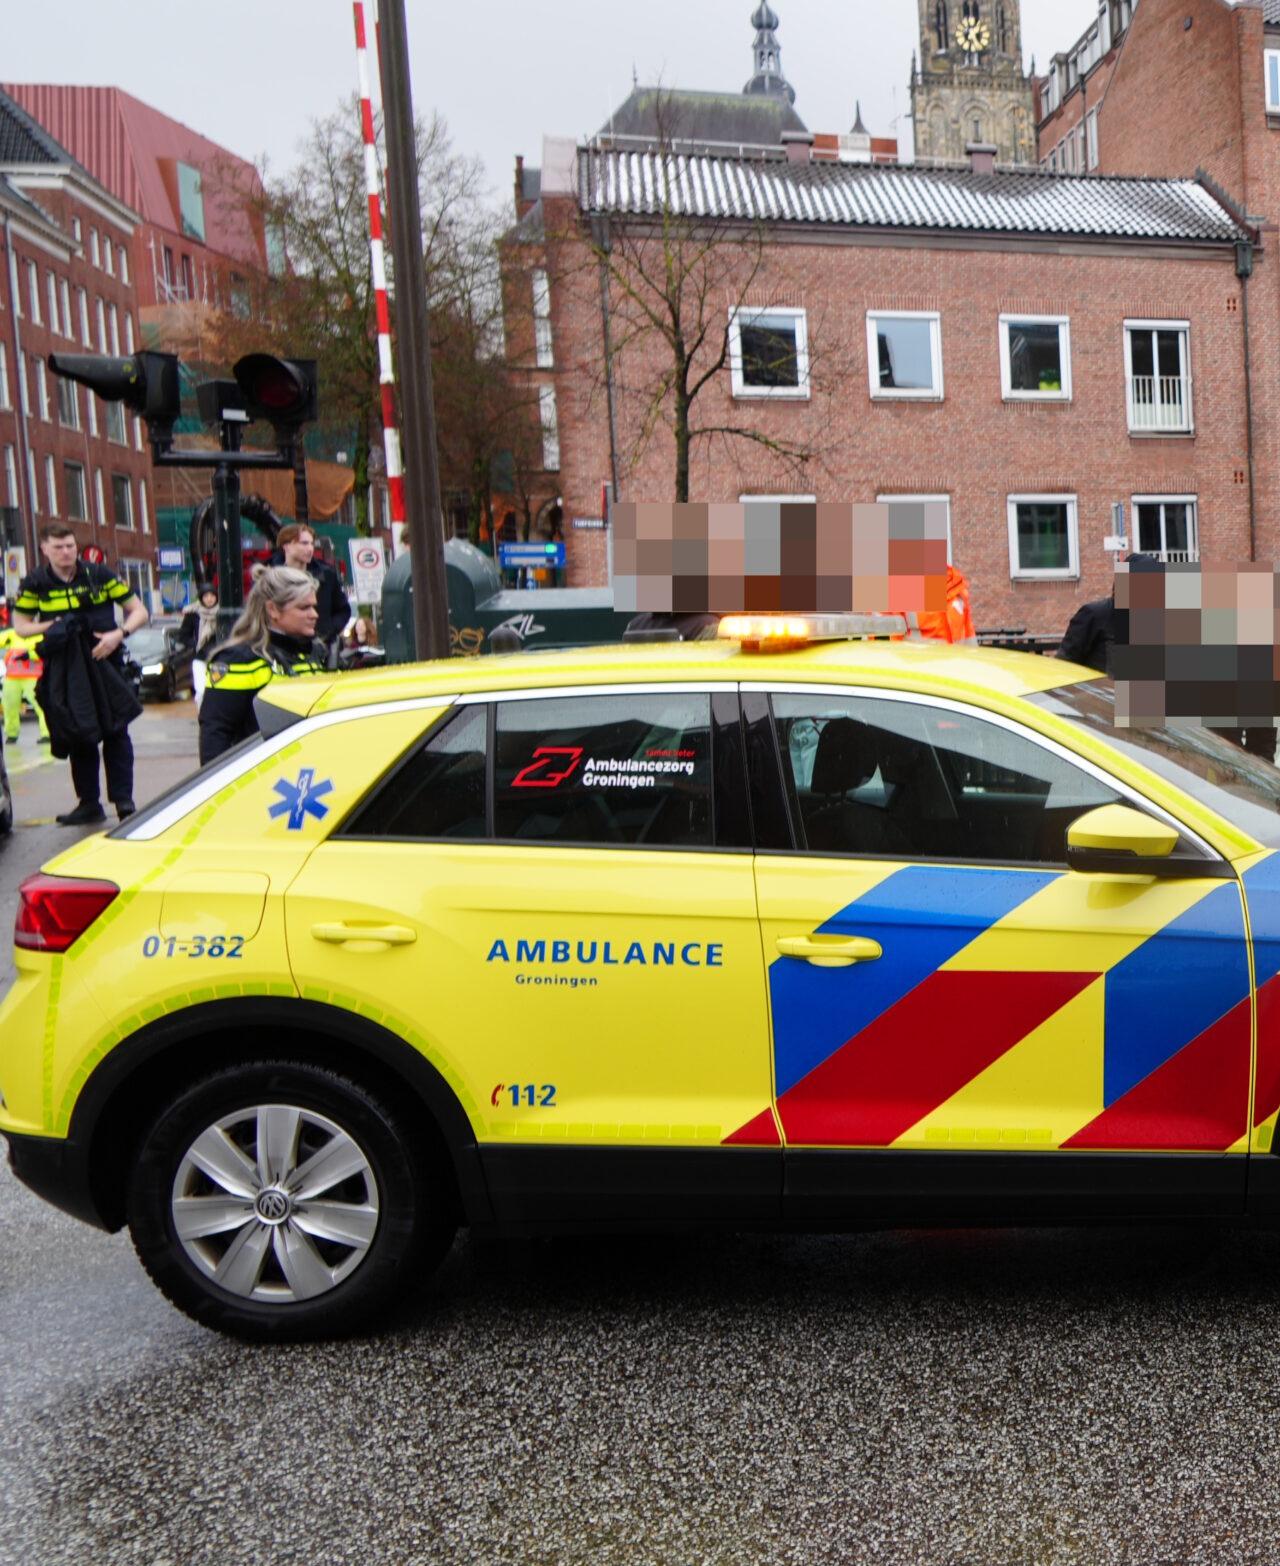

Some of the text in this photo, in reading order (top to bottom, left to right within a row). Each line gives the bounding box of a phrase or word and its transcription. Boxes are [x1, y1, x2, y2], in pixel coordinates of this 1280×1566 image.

[674, 747, 696, 758] eter
[584, 758, 695, 776] Ambulancezorg
[582, 772, 655, 790] Groningen
[142, 935, 245, 958] 01-382
[486, 939, 723, 967] AMBULANCE
[515, 974, 598, 988] Groningen
